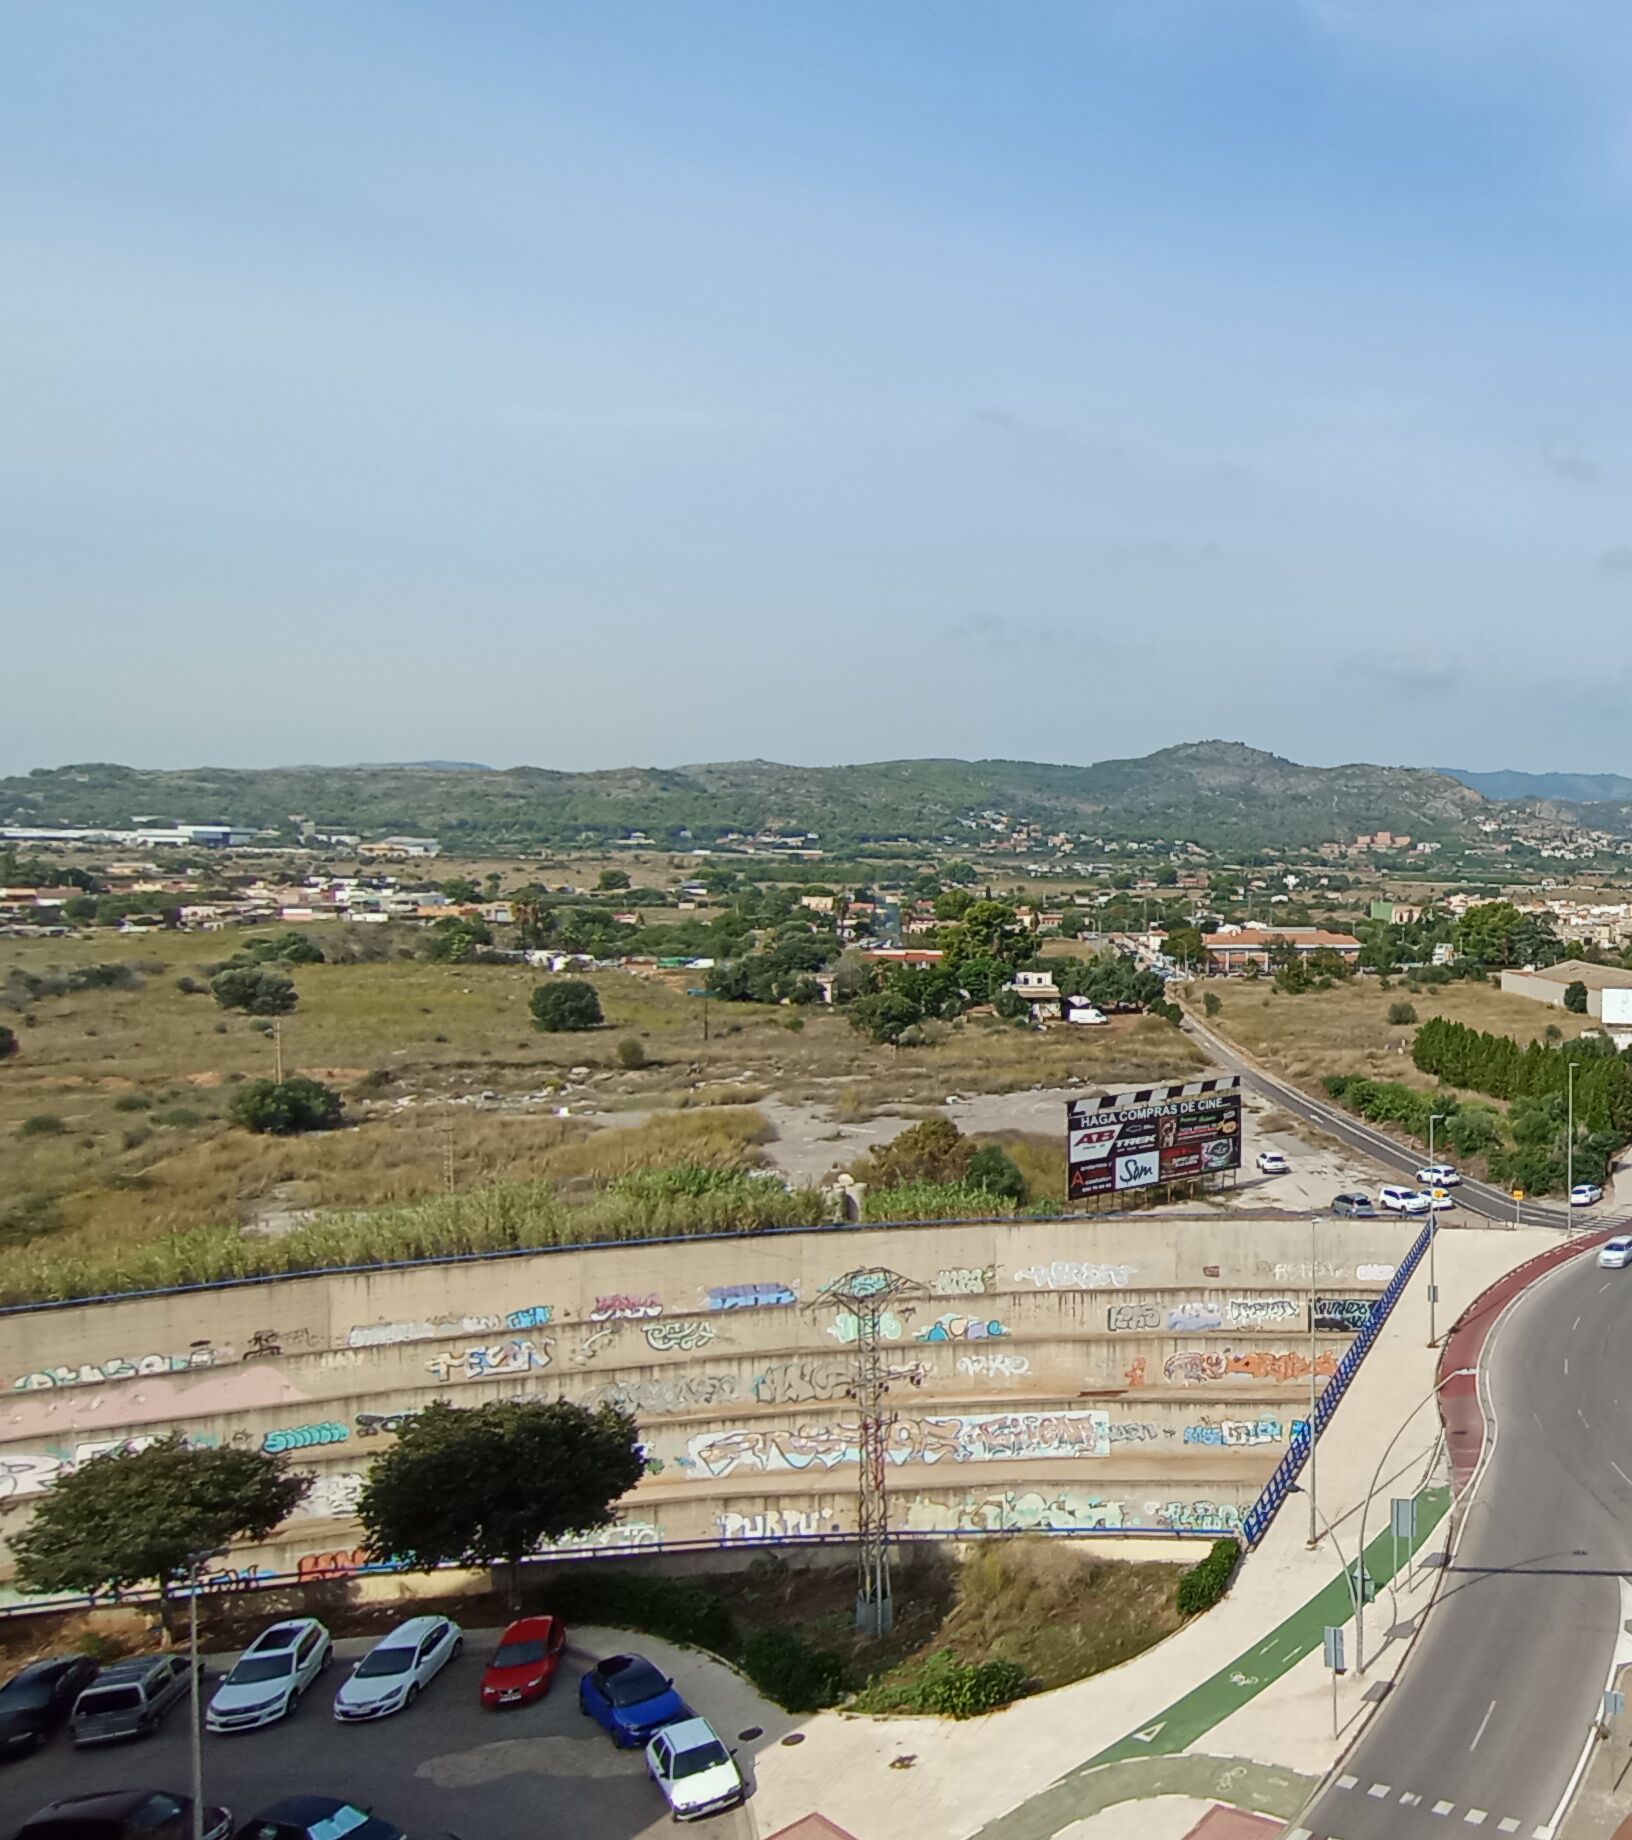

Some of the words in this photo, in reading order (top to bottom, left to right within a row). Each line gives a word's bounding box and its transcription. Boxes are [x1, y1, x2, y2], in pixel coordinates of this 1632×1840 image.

[1081, 1114, 1117, 1128] HAGA
[1119, 1104, 1178, 1122] COMPRAS
[1180, 1102, 1196, 1113] DE
[1116, 1134, 1157, 1147] TREK
